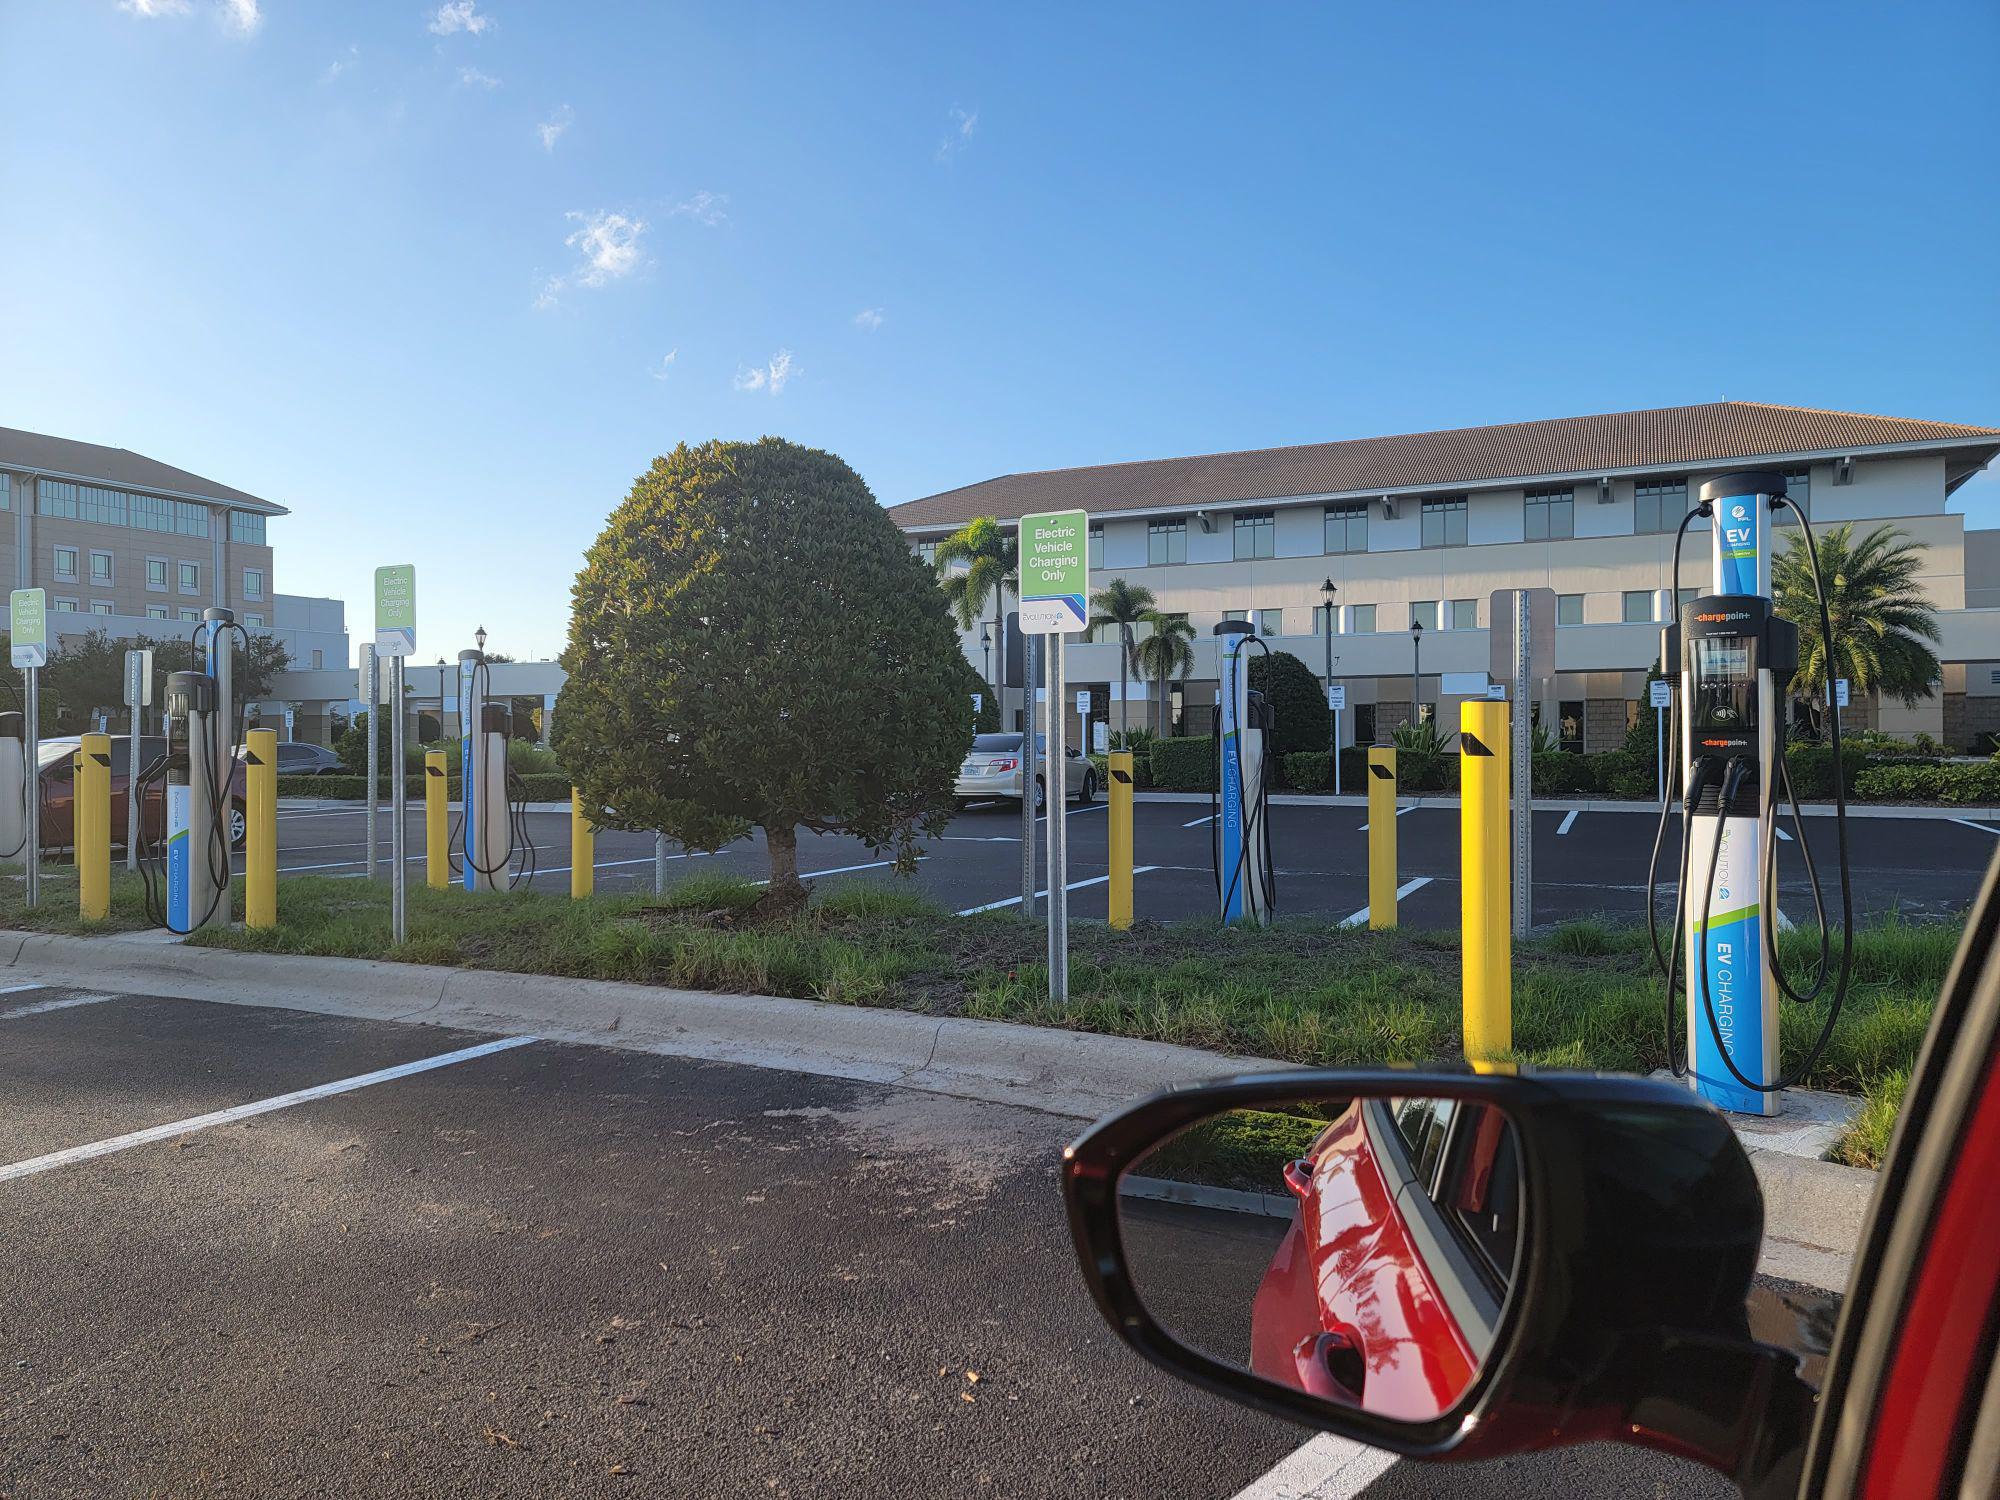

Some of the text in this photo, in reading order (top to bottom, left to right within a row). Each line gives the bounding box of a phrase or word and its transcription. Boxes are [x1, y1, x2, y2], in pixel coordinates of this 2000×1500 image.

[1035, 526, 1076, 540] Electric
[1726, 527, 1751, 542] EV
[1034, 541, 1073, 554] Vehicle
[1029, 555, 1078, 569] Charging
[383, 577, 408, 586] Electric
[1041, 569, 1066, 583] Only
[383, 587, 407, 596] Vehicle
[18, 599, 40, 607] Electric
[380, 598, 410, 608] Charging
[18, 608, 38, 616] Vehicle
[387, 608, 403, 618] Only
[15, 617, 41, 626] Charging
[1227, 768, 1237, 828] CHARGING
[173, 849, 179, 860] EV
[1717, 943, 1732, 965] EV
